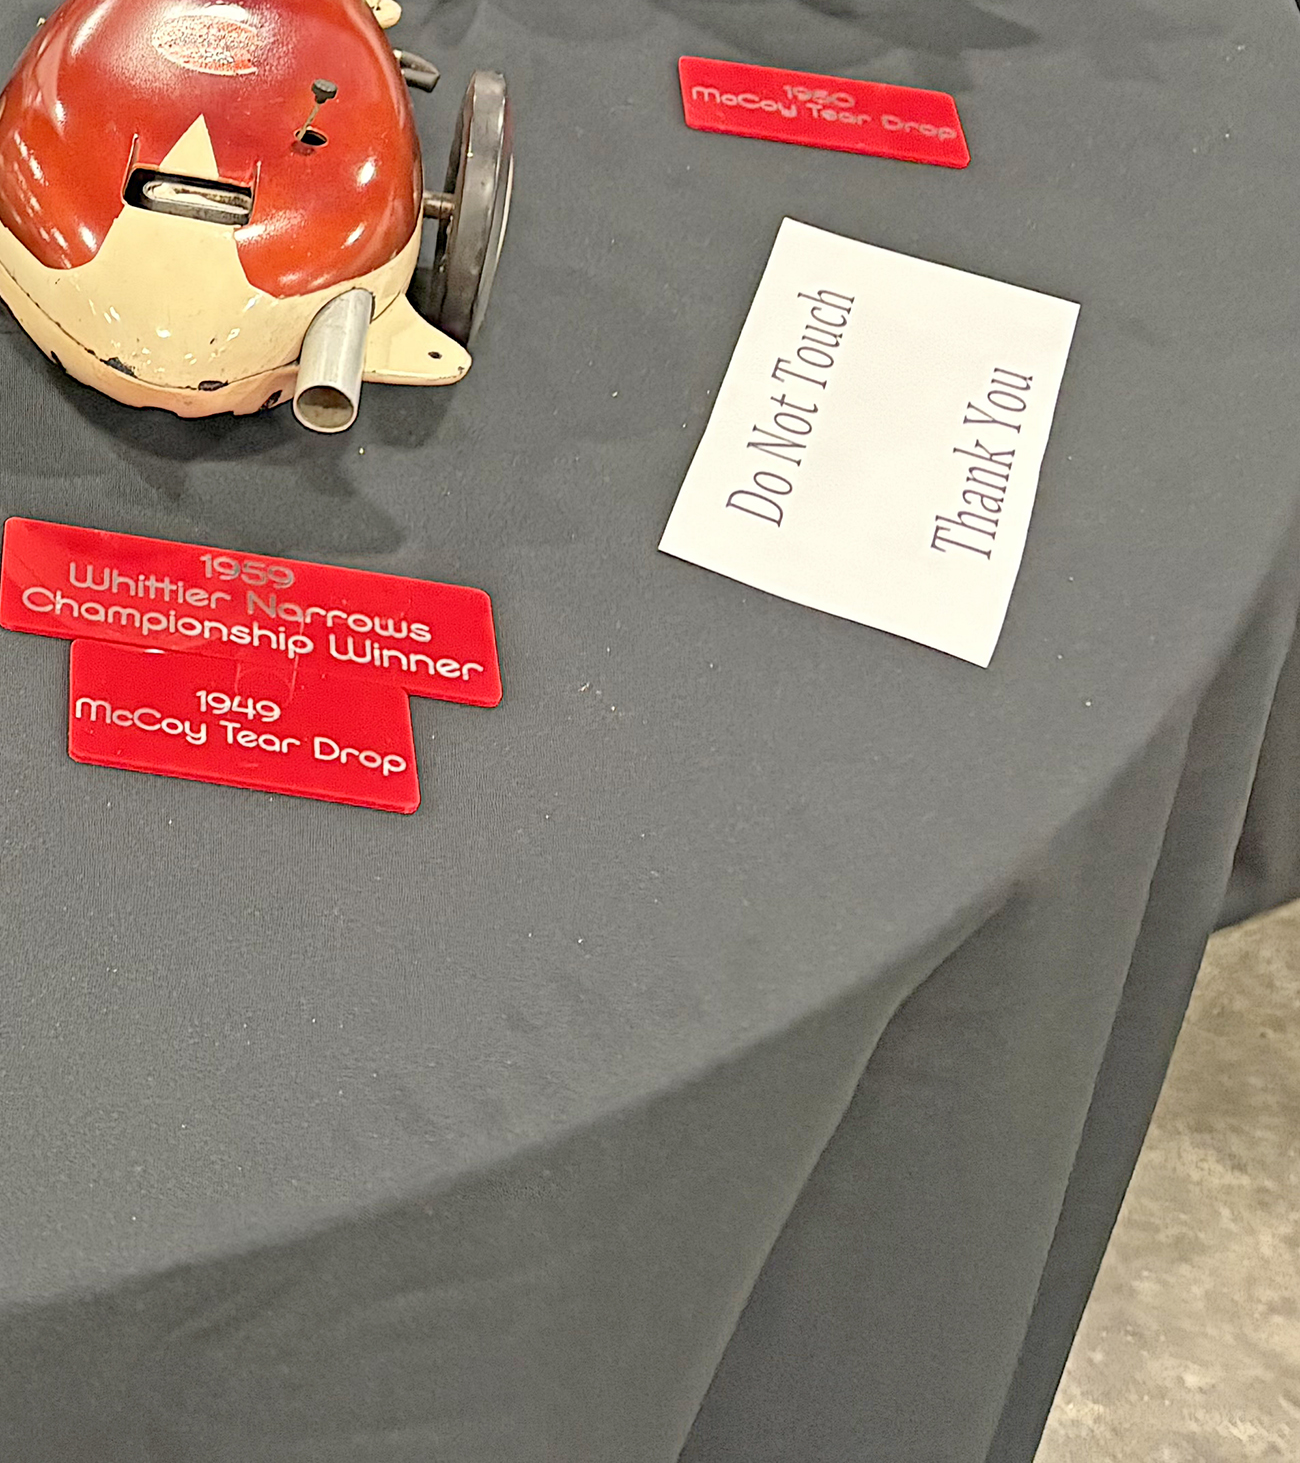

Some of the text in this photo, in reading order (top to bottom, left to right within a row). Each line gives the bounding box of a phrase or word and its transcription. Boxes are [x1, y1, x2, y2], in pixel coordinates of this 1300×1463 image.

[691, 86, 958, 141] McCoy Tear Drop
[725, 289, 855, 527] Do Not Touch
[930, 367, 1033, 560] Thank You
[68, 561, 432, 643] Whittier Narrows
[201, 553, 295, 589] 1959
[21, 585, 484, 681] Championship Winner
[75, 696, 407, 777] McCoy Tear Drop
[196, 689, 281, 723] 1949
